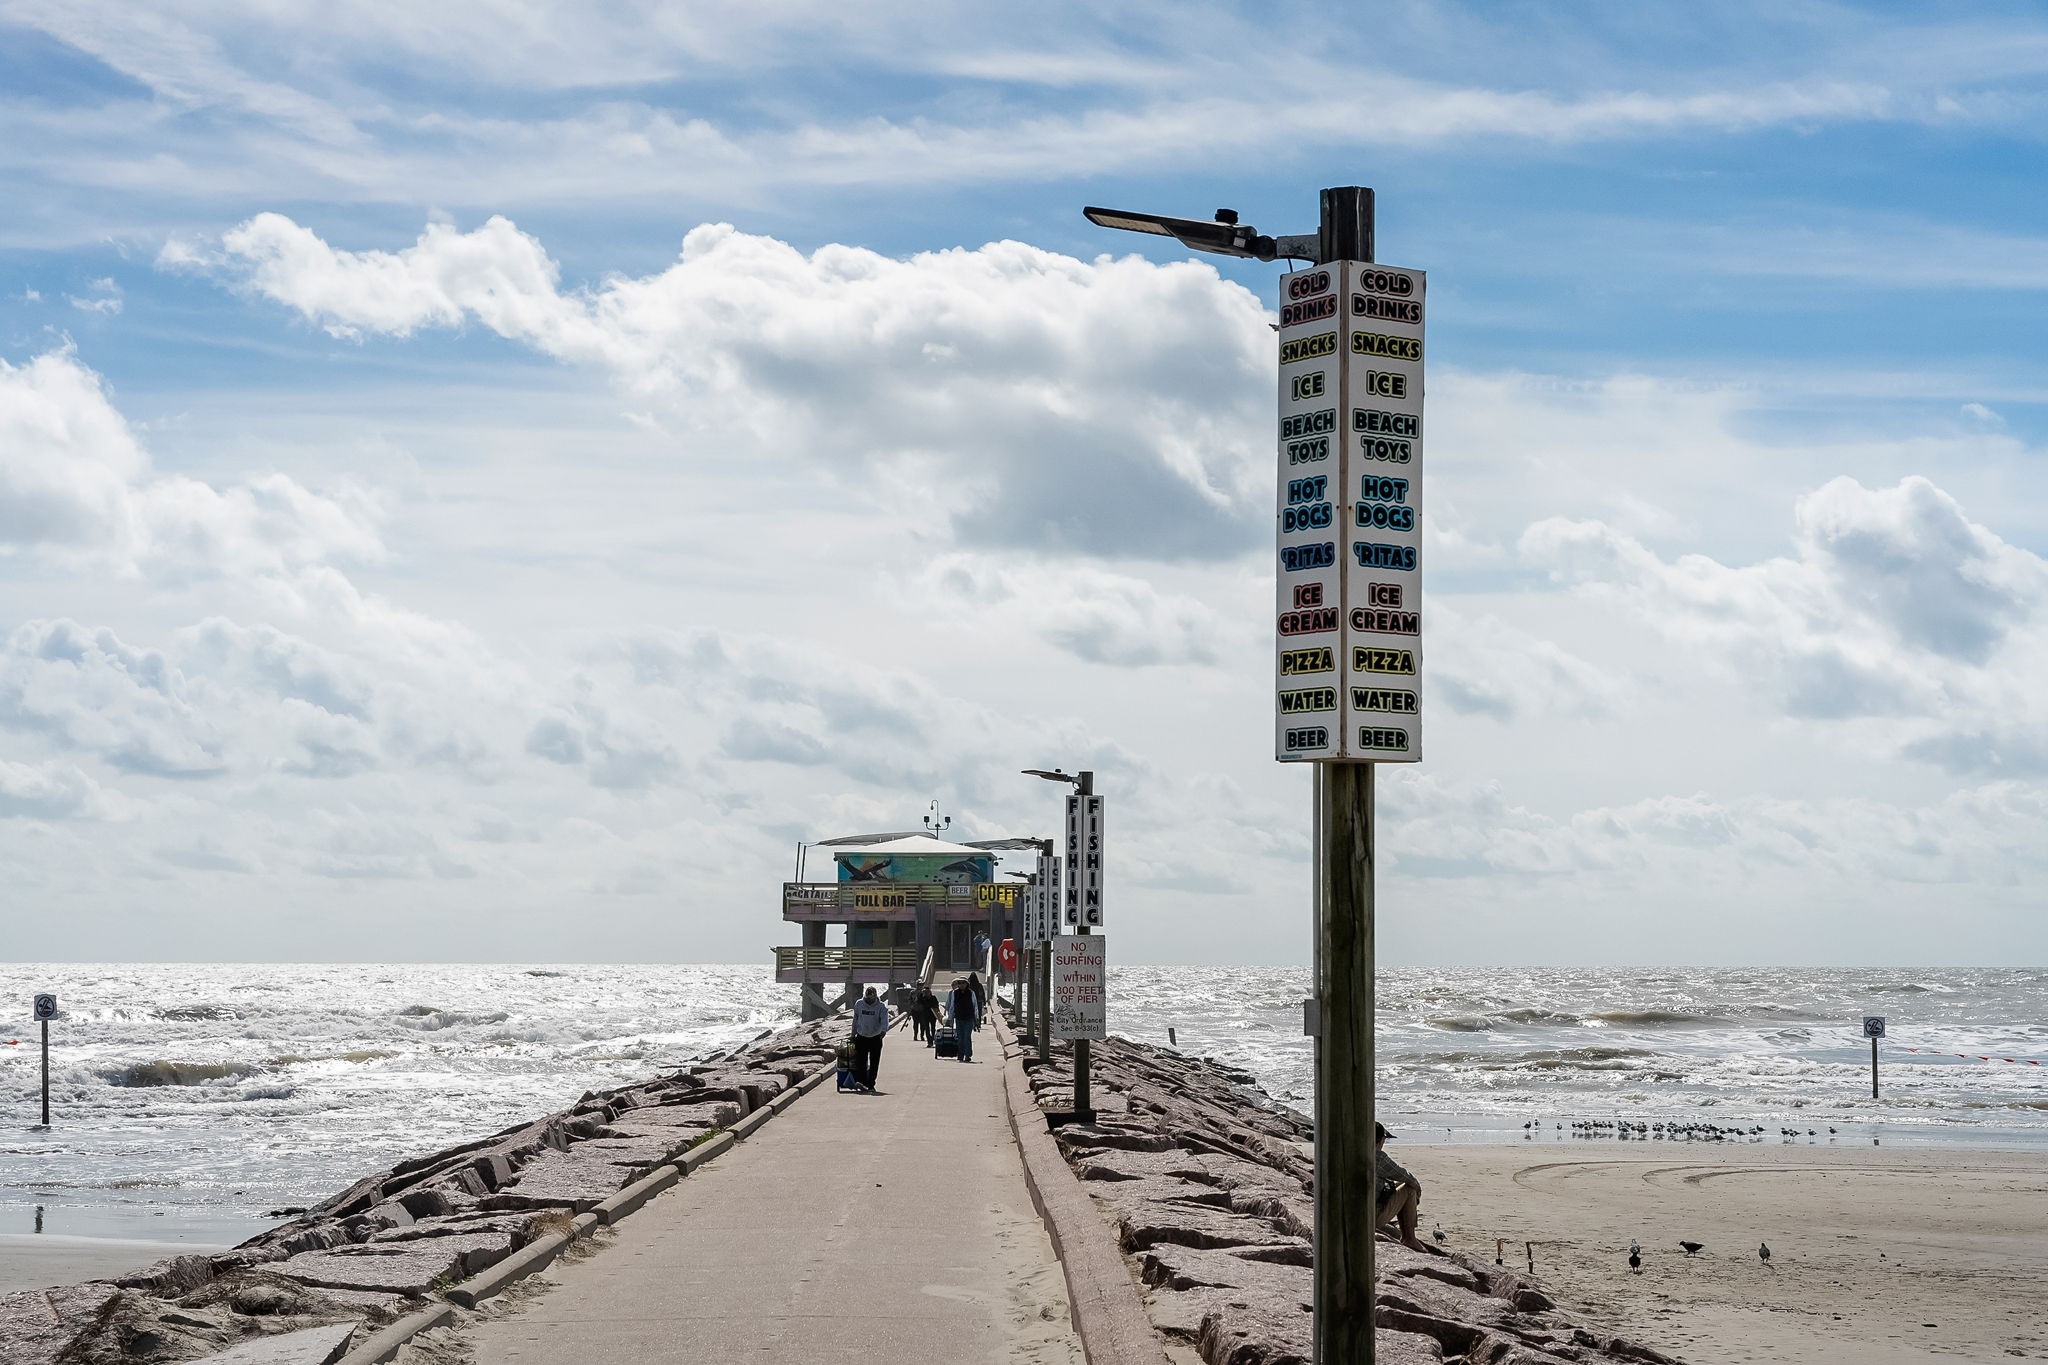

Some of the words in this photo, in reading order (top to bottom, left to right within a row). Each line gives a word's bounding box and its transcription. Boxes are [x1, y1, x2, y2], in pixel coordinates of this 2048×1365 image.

[1289, 271, 1329, 299] COLD
[1361, 270, 1412, 296] COLD
[1282, 295, 1336, 327] DRINKS
[1353, 294, 1421, 323] DRINKS
[1281, 332, 1337, 364] SNACKS
[1352, 332, 1421, 361] SNACKS
[1293, 372, 1324, 400] ICE
[1367, 371, 1406, 398] ICE
[1282, 409, 1335, 440] BEACH
[1354, 408, 1418, 438] BEACH
[1288, 437, 1328, 464] TOYS
[1362, 437, 1410, 463] TOYS
[1289, 476, 1326, 504] HOT
[1362, 475, 1407, 503] HOT
[1283, 503, 1331, 532] DOGS
[1356, 502, 1413, 531] DOGS
[1294, 583, 1322, 608] ICE
[1369, 583, 1401, 607] ICE
[1278, 608, 1338, 635] CREAM
[1350, 608, 1419, 635] CREAM
[1281, 647, 1335, 675] PIZZA
[1353, 647, 1415, 675] PIZZA
[1279, 687, 1336, 713] WATER
[1351, 687, 1417, 714] WATER
[1286, 727, 1328, 750] BEER
[1360, 726, 1408, 750] BEER
[1068, 798, 1078, 923] FISHING
[1087, 798, 1099, 924] FISHING
[855, 895, 879, 907] FULL
[882, 895, 905, 907] BAR
[951, 886, 968, 894] BEER
[1056, 955, 1102, 965] SURFING
[1071, 942, 1087, 952] NO
[1056, 986, 1075, 995] 300
[1079, 986, 1103, 995] FEET
[1063, 974, 1096, 982] WITHIN
[1060, 995, 1074, 1003] OF
[1077, 995, 1098, 1003] PIER
[1056, 1017, 1069, 1025] City
